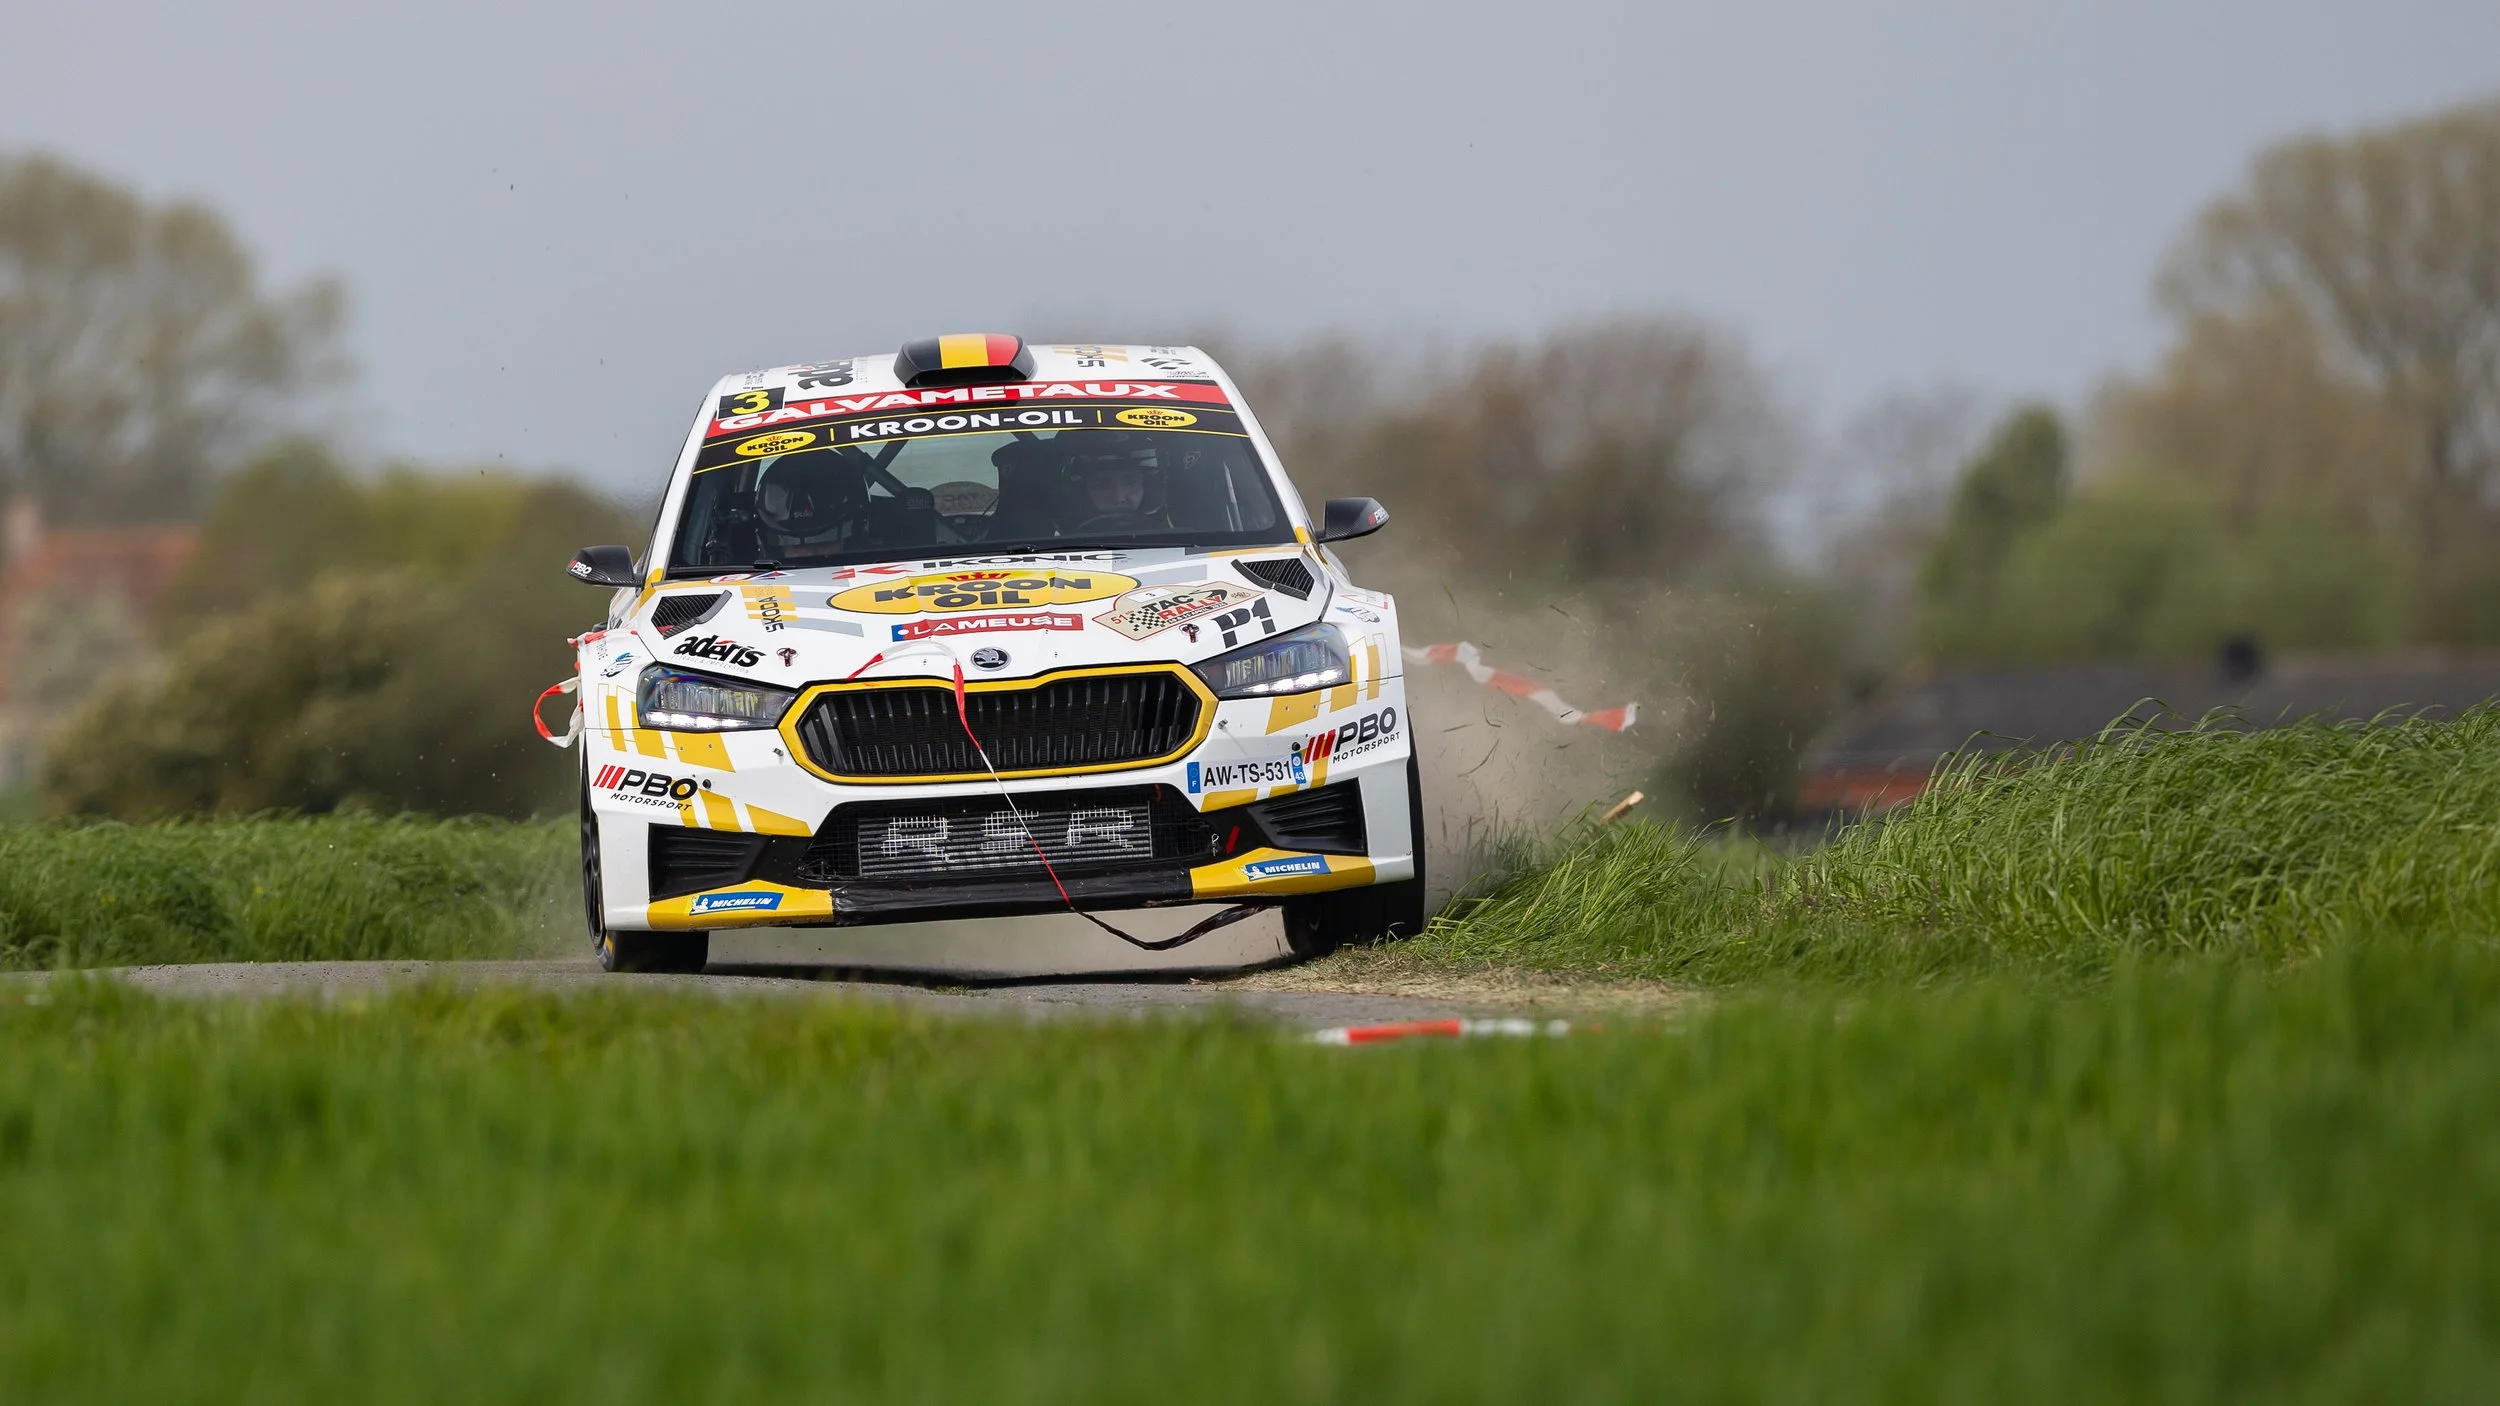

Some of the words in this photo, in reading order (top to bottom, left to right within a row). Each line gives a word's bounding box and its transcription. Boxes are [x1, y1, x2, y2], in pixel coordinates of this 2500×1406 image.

[719, 383, 1181, 430] GALVAMETAUX
[731, 390, 770, 415] 3
[850, 410, 1083, 439] KROON-OIL
[1127, 414, 1185, 422] KROON
[747, 436, 804, 452] KROON
[762, 444, 788, 453] OIL
[573, 561, 592, 574] PBO
[923, 554, 1127, 568] IKONIC
[875, 577, 1092, 602] KROON
[934, 591, 1030, 607] OIL
[1142, 595, 1194, 612] TAC
[1157, 595, 1223, 620] RALLY
[1211, 597, 1277, 649] P1
[1334, 706, 1397, 753] PBO
[1332, 731, 1400, 763] MOTORSPORT
[1203, 761, 1293, 787] AW-TS-531
[1295, 771, 1305, 780] 43
[618, 768, 698, 800] PBO
[610, 792, 692, 811] MOTORSPORT
[1264, 860, 1321, 874] MICHELIN
[710, 896, 773, 908] MICHELIN
